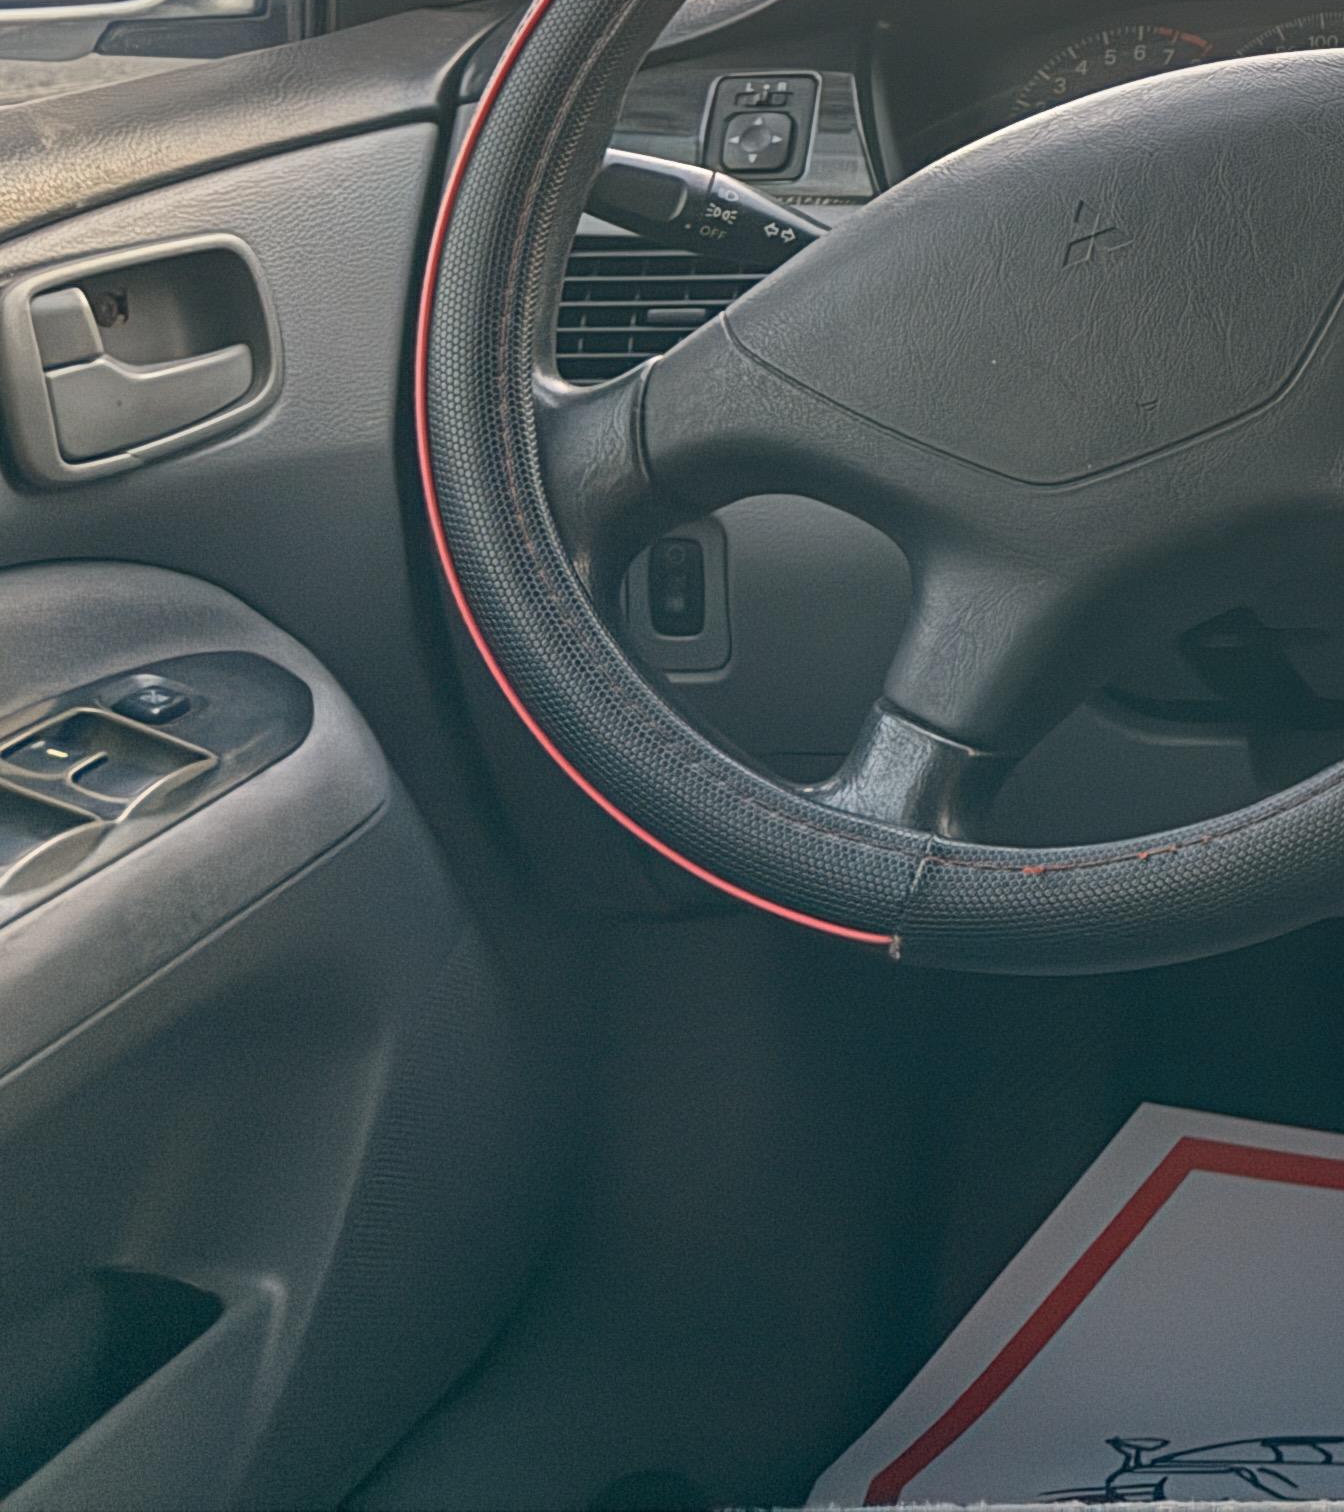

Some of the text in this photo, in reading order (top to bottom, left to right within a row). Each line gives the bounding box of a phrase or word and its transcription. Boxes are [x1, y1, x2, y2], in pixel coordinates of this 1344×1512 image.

[1053, 44, 1175, 94] 3 4 5 6 7
[700, 224, 728, 240] OFF
